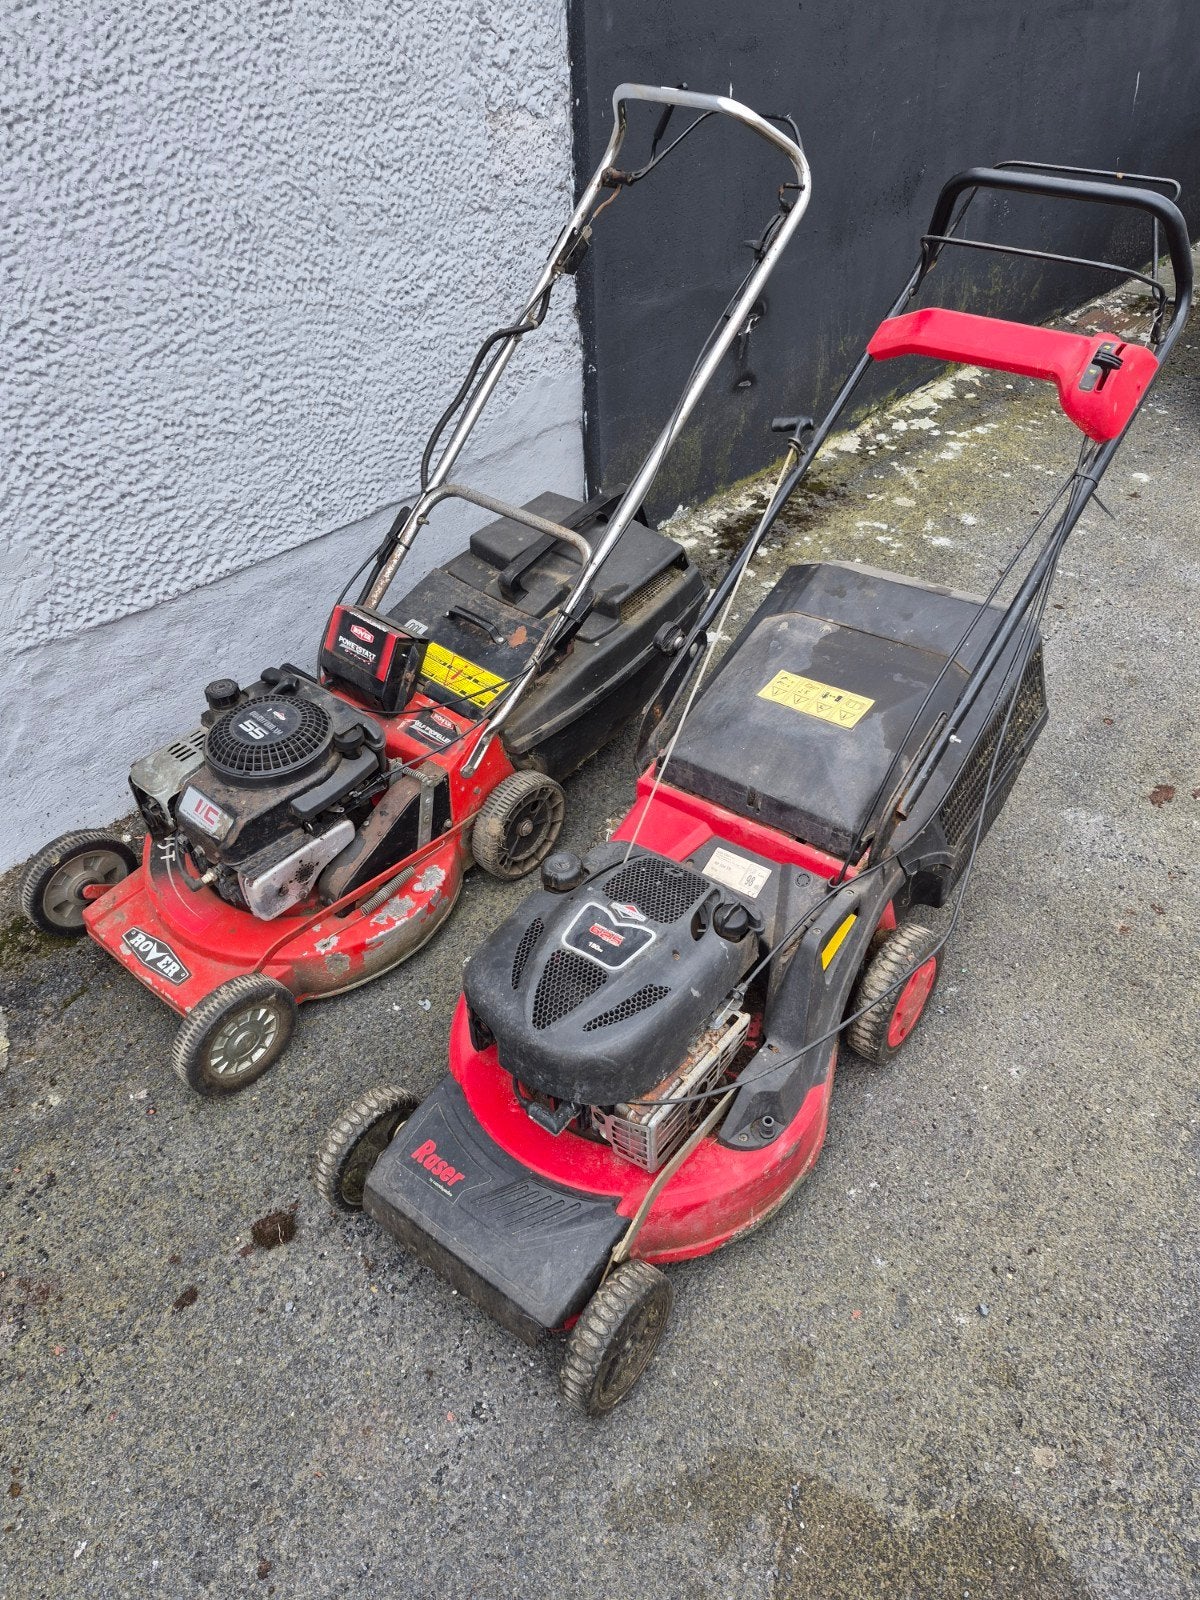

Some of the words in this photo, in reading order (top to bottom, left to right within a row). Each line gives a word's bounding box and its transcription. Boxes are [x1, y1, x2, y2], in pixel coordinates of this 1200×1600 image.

[352, 625, 373, 642] ROVER
[338, 635, 377, 660] POWERSTART
[237, 718, 269, 741] 55
[743, 873, 756, 888] 98
[588, 924, 623, 947] 625
[129, 932, 181, 978] ROVER
[411, 1139, 465, 1186] Raser
